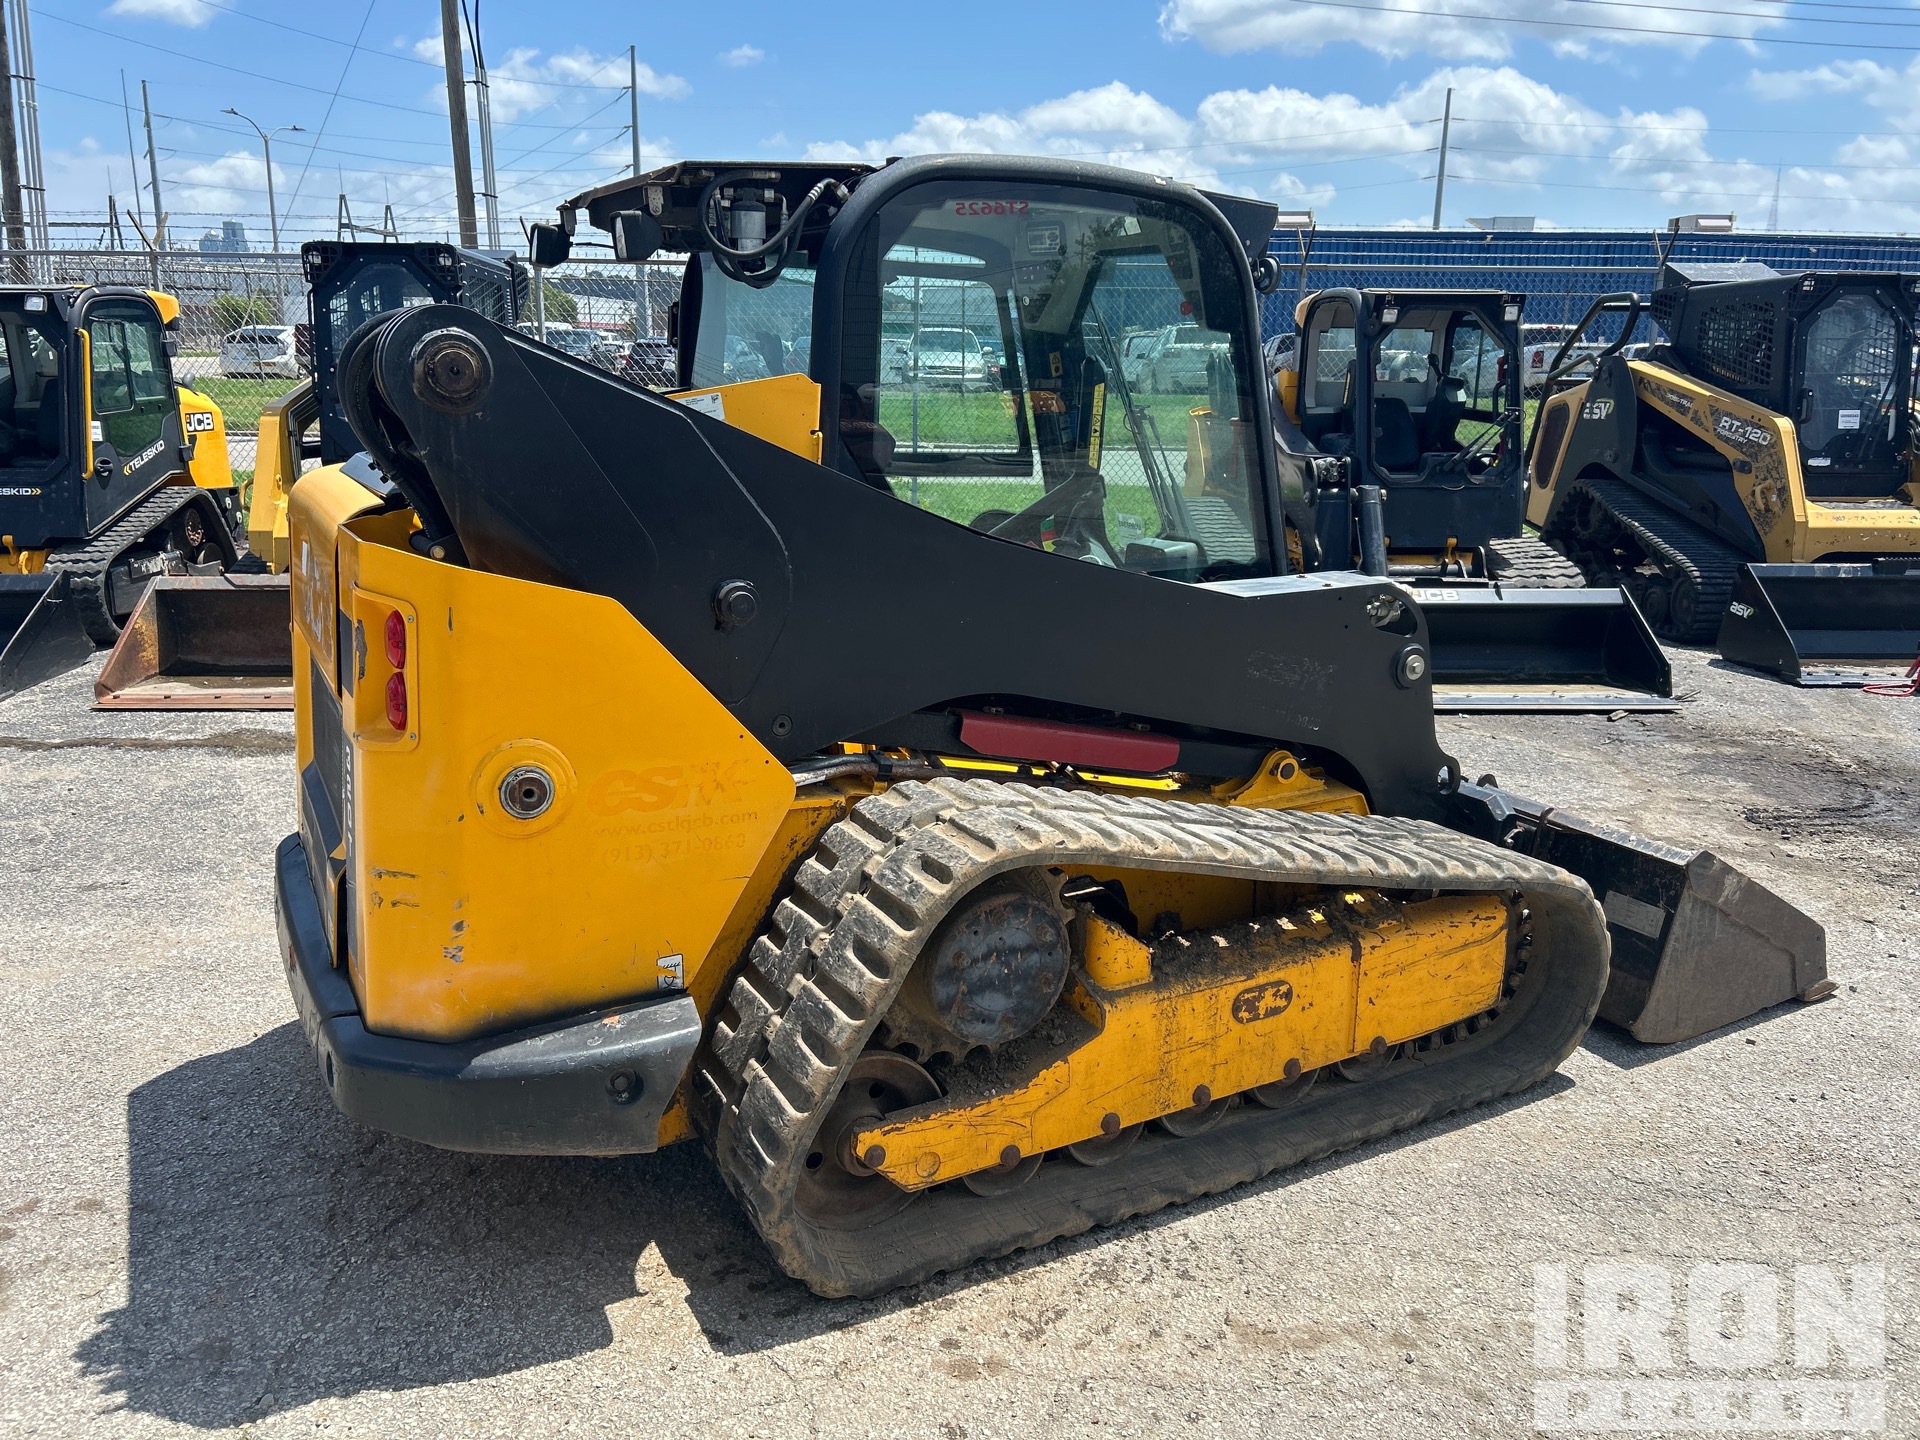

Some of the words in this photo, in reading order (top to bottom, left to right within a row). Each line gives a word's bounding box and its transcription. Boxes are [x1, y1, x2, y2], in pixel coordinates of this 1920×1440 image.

[185, 413, 214, 432] JCB
[1719, 416, 1771, 445] RT-120
[129, 440, 165, 471] TELESKID
[1411, 589, 1460, 601] JCB
